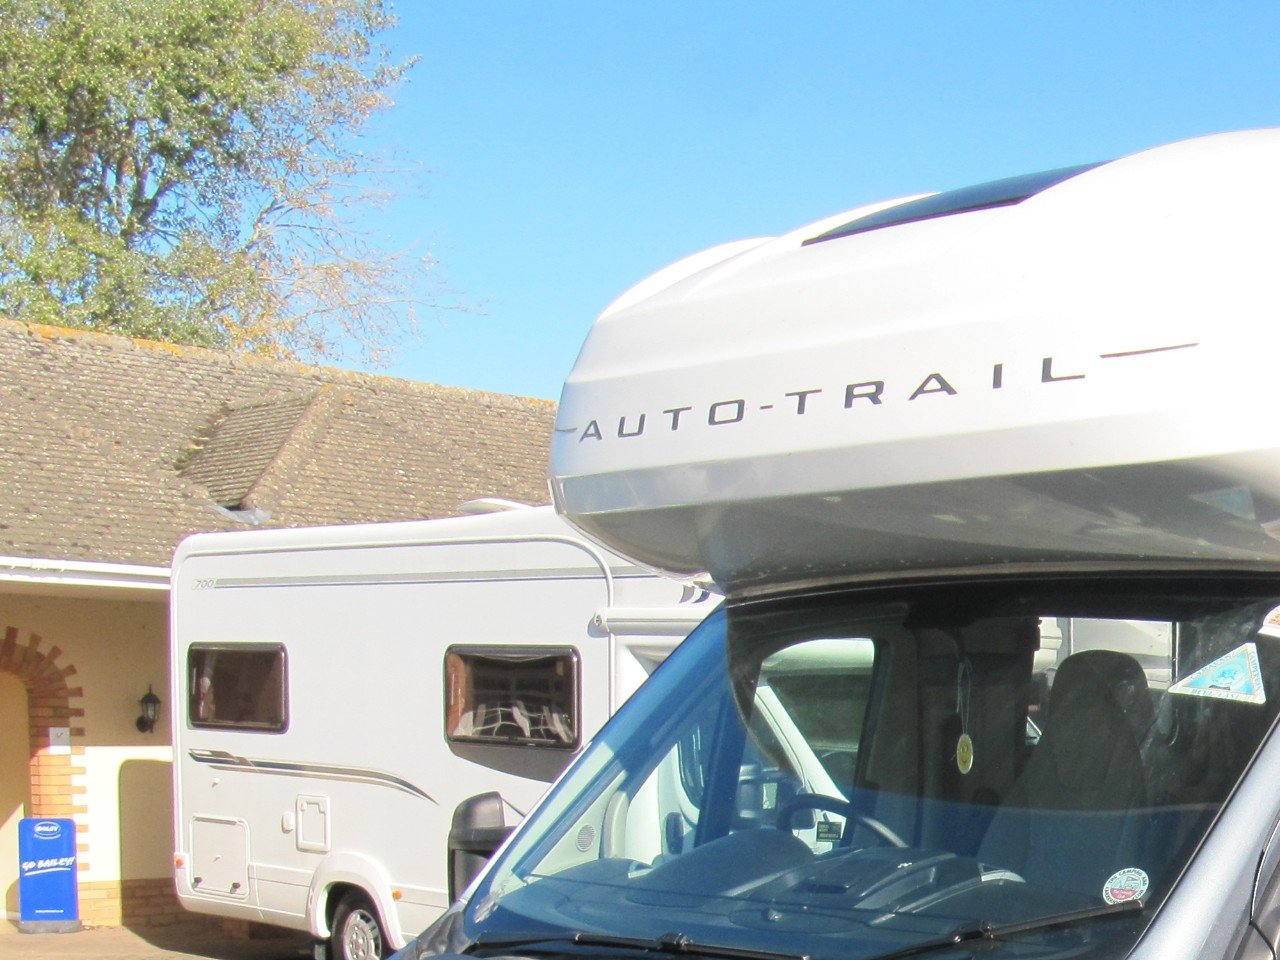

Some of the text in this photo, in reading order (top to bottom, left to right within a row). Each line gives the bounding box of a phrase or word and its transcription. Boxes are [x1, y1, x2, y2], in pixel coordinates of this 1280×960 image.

[577, 356, 1086, 443] AUTO-TRAIL
[22, 856, 75, 871] GO BAILEY!
